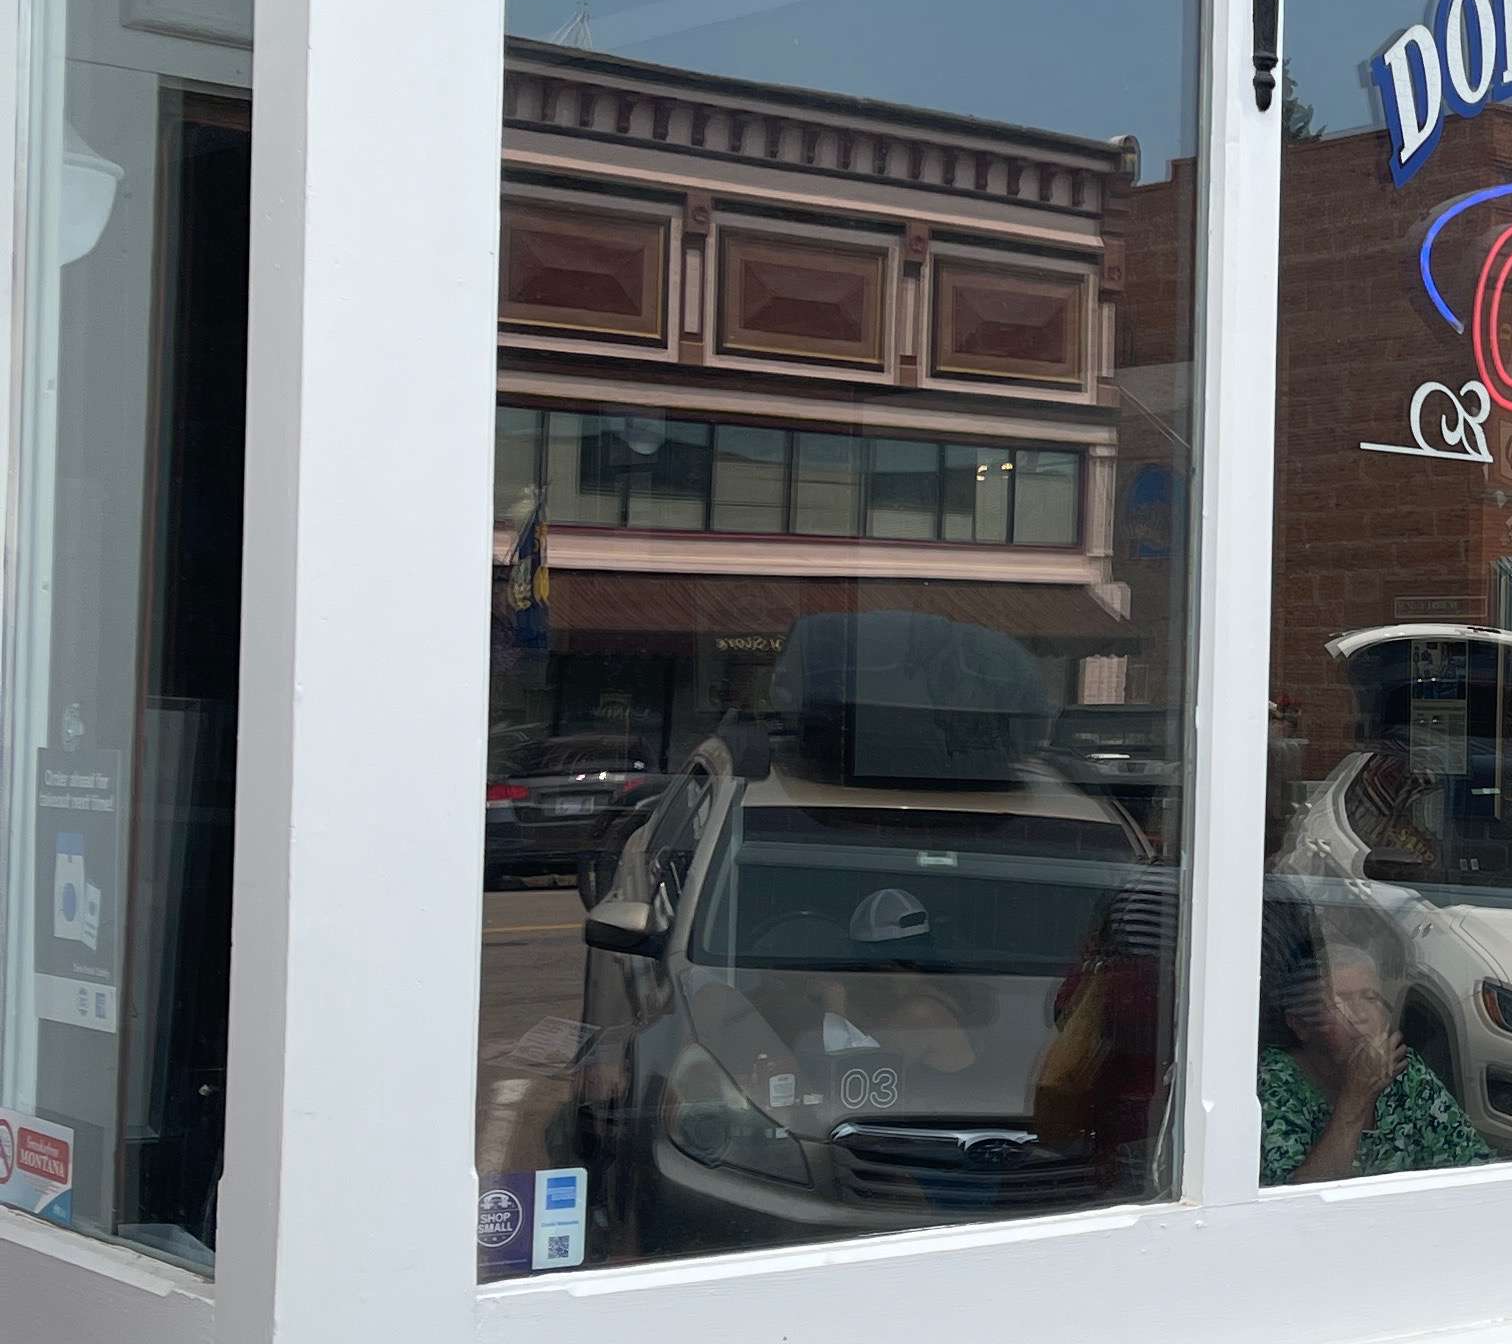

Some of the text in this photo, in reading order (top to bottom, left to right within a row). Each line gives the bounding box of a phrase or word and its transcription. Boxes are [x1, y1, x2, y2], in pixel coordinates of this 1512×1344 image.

[840, 1067, 899, 1109] 03
[19, 1148, 65, 1178] MONTANA
[478, 1221, 513, 1233] SMALL
[480, 1211, 511, 1224] SHOP
